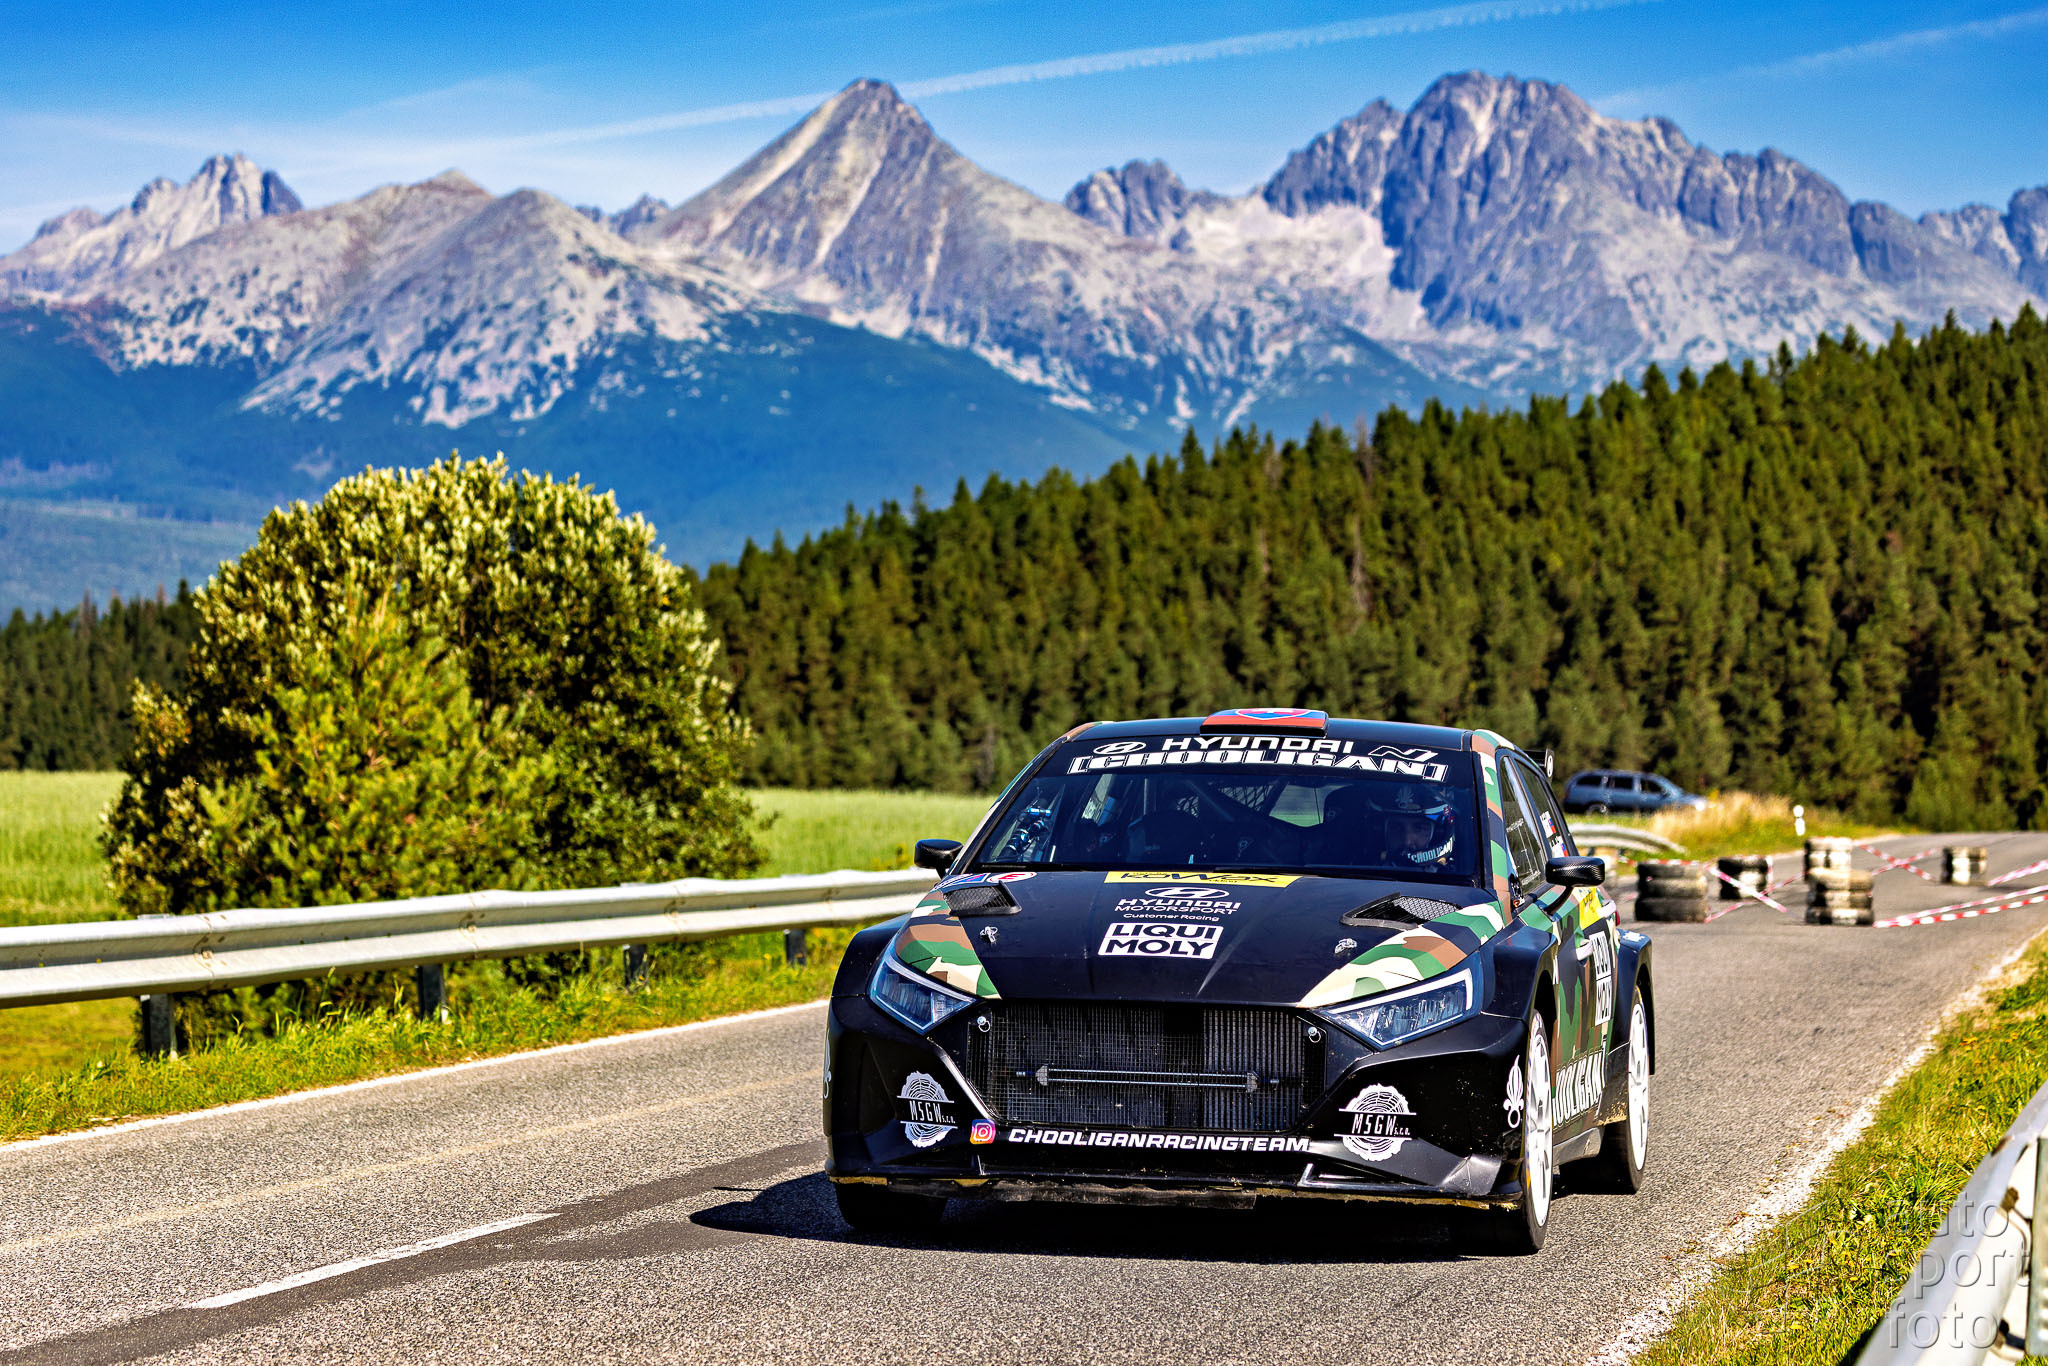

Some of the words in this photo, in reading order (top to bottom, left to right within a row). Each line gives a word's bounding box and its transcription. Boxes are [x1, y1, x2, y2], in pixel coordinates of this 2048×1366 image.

[1162, 736, 1354, 754] HYUNDAI
[1114, 905, 1238, 915] MOTORSPORT
[1117, 898, 1241, 909] HYUNDAI
[1181, 914, 1220, 922] Racing
[1112, 924, 1217, 939] LIQUI
[1105, 939, 1214, 956] MOLY
[909, 1100, 942, 1123] MSGW
[1351, 1113, 1397, 1136] MSGW
[1008, 1128, 1310, 1151] CHOOLIGANRACINGTEAM
